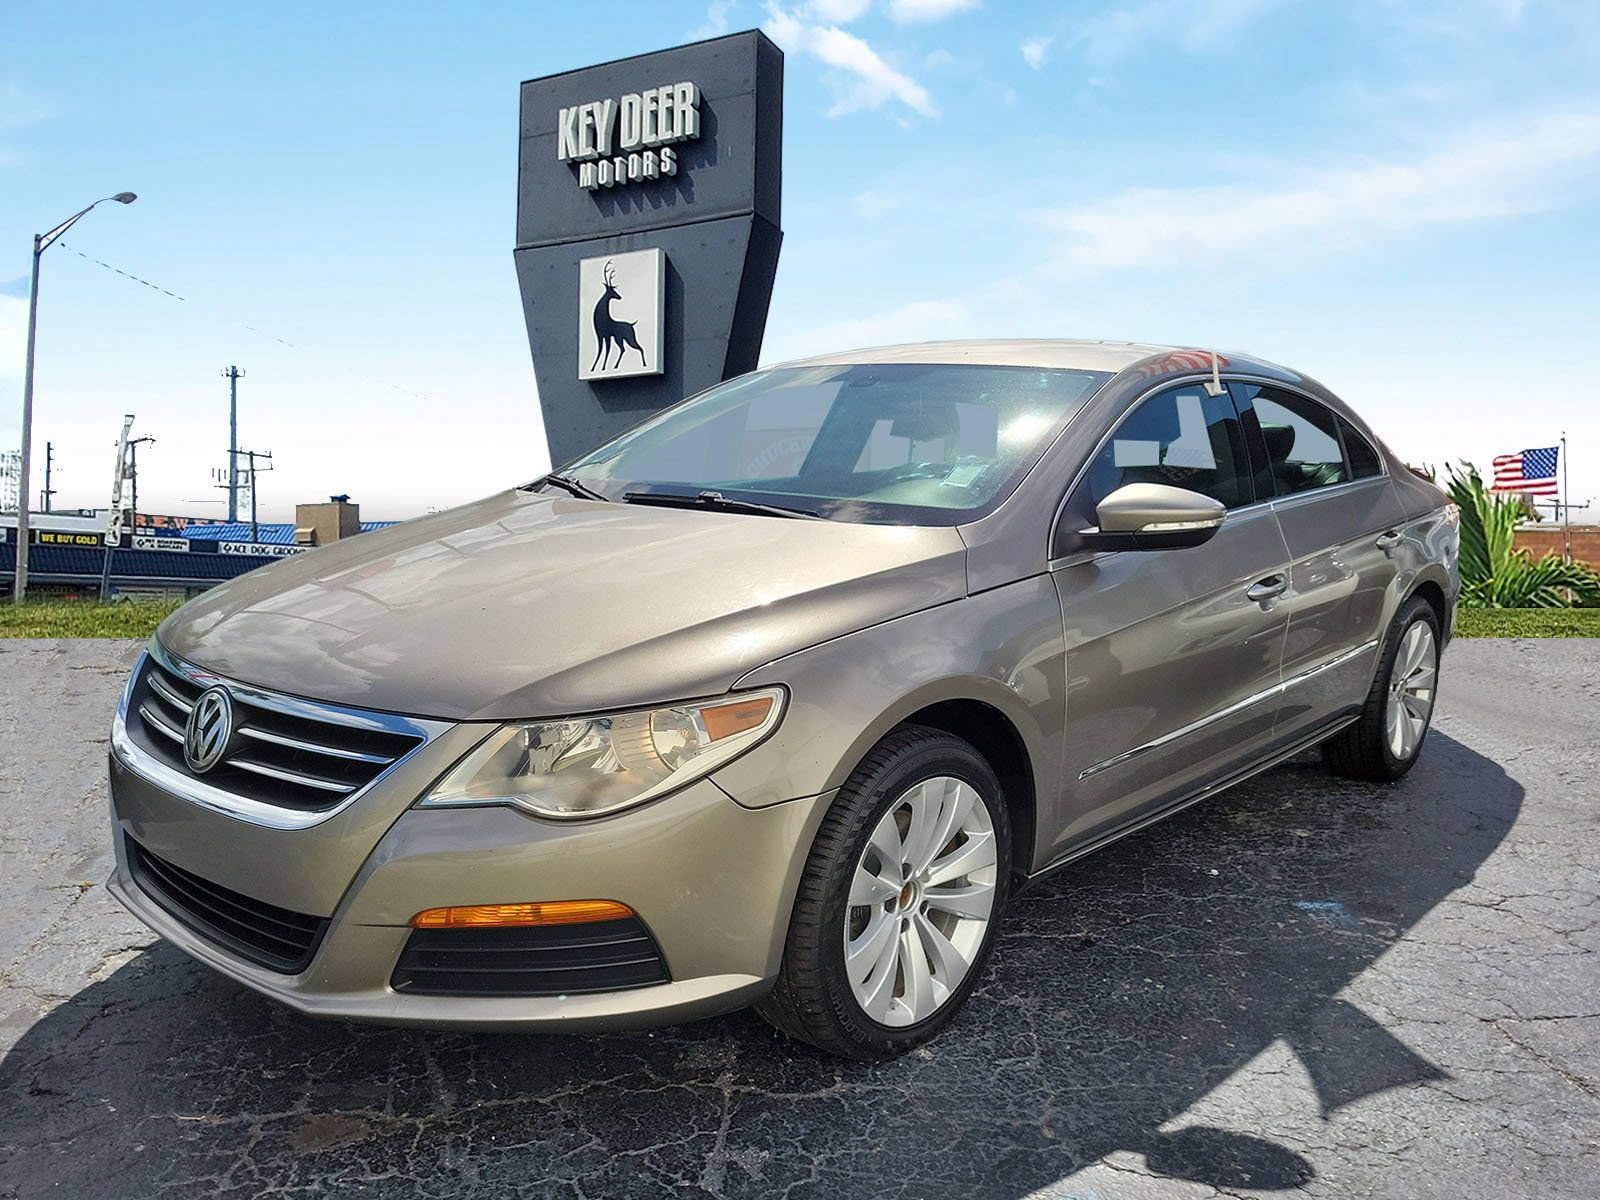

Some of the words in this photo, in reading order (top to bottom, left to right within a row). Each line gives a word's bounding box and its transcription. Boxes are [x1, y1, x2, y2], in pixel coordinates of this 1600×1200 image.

[558, 98, 617, 162] KEY
[620, 81, 700, 151] DEER
[579, 147, 677, 191] MOTORS
[41, 533, 55, 543] WE
[57, 534, 75, 544] BUY
[76, 535, 98, 545] GOLD
[232, 543, 247, 554] ACE
[251, 545, 270, 555] DOG
